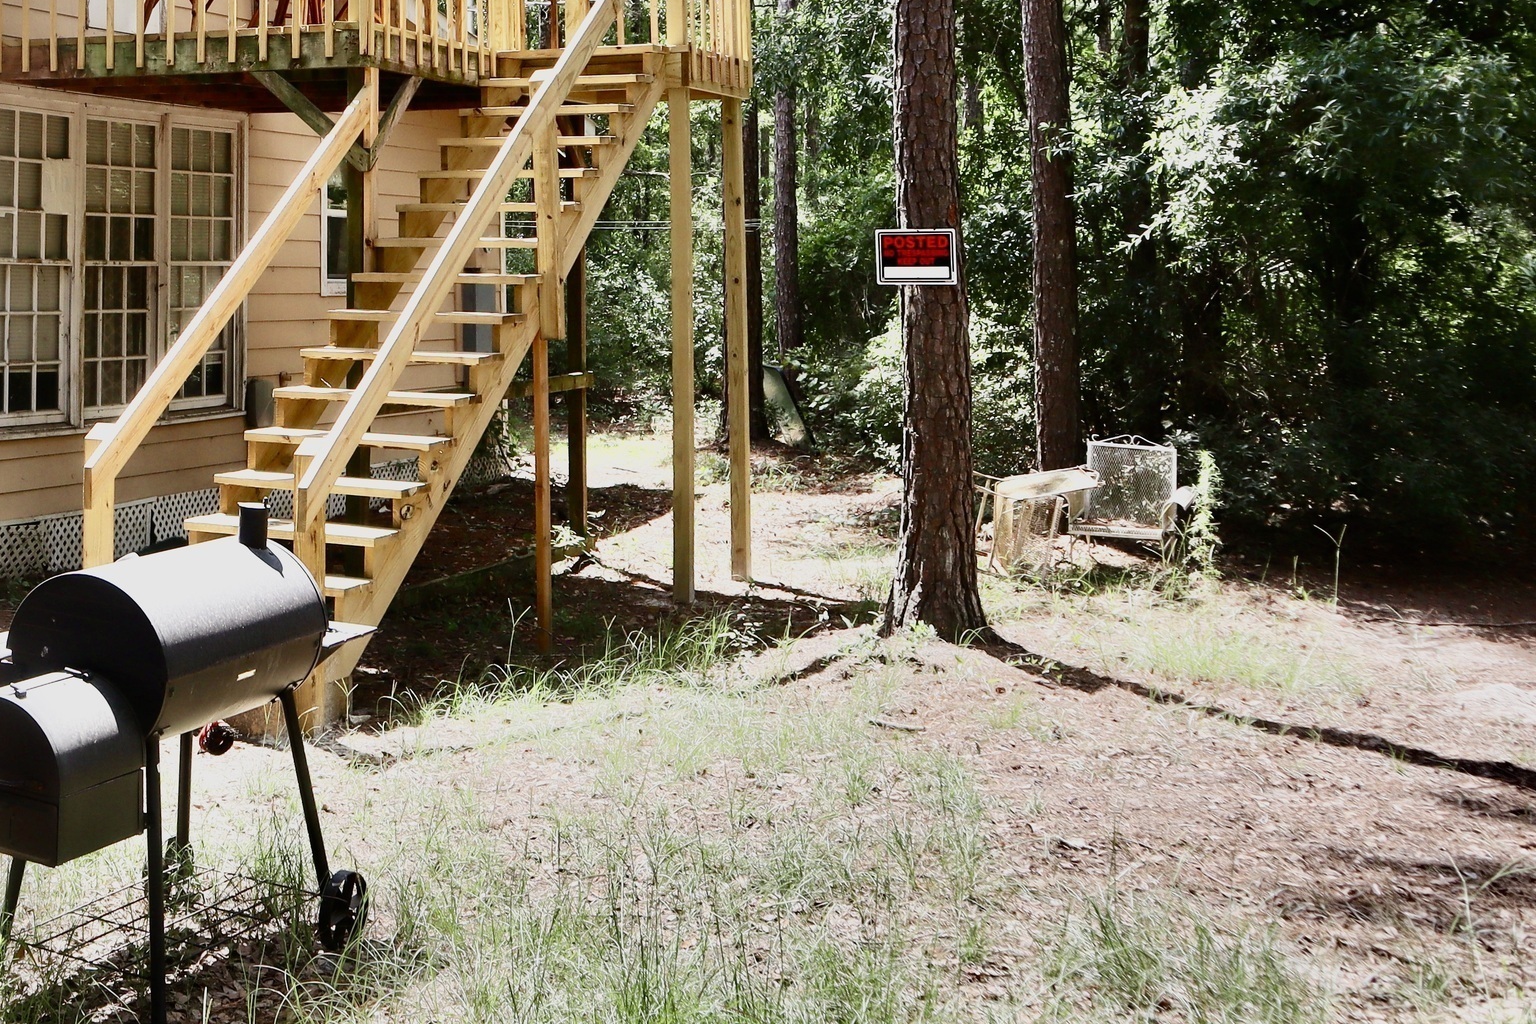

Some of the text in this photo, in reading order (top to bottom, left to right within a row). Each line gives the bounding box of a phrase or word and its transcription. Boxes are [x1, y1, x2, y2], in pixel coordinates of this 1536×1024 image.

[883, 236, 948, 248] POSTED
[897, 257, 935, 265] KEEP OUT
